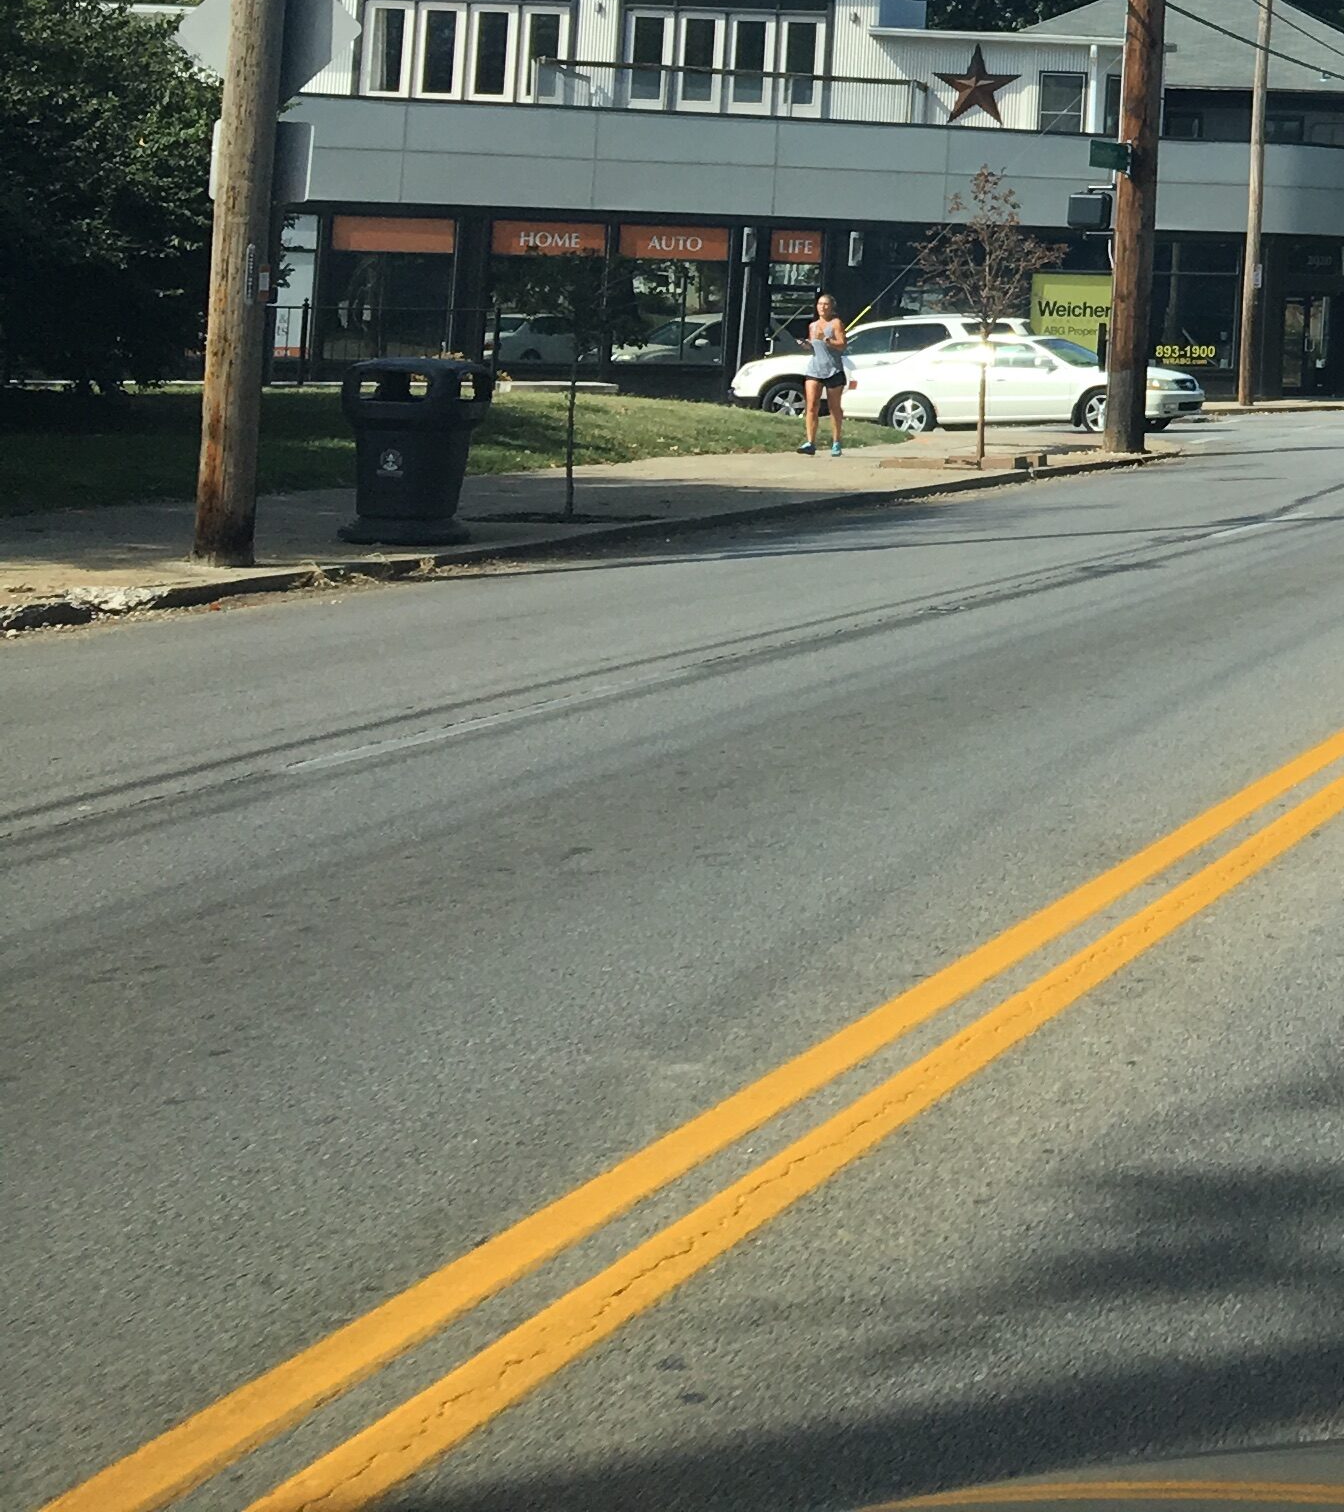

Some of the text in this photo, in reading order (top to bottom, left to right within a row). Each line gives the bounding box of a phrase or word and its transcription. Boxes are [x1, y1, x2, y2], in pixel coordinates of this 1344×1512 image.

[519, 231, 581, 248] HOME
[647, 235, 703, 252] AUTO
[778, 239, 813, 255] LIFE
[1038, 300, 1111, 318] Weicher
[1043, 326, 1066, 336] ABG
[1155, 345, 1216, 358] 893-1900
